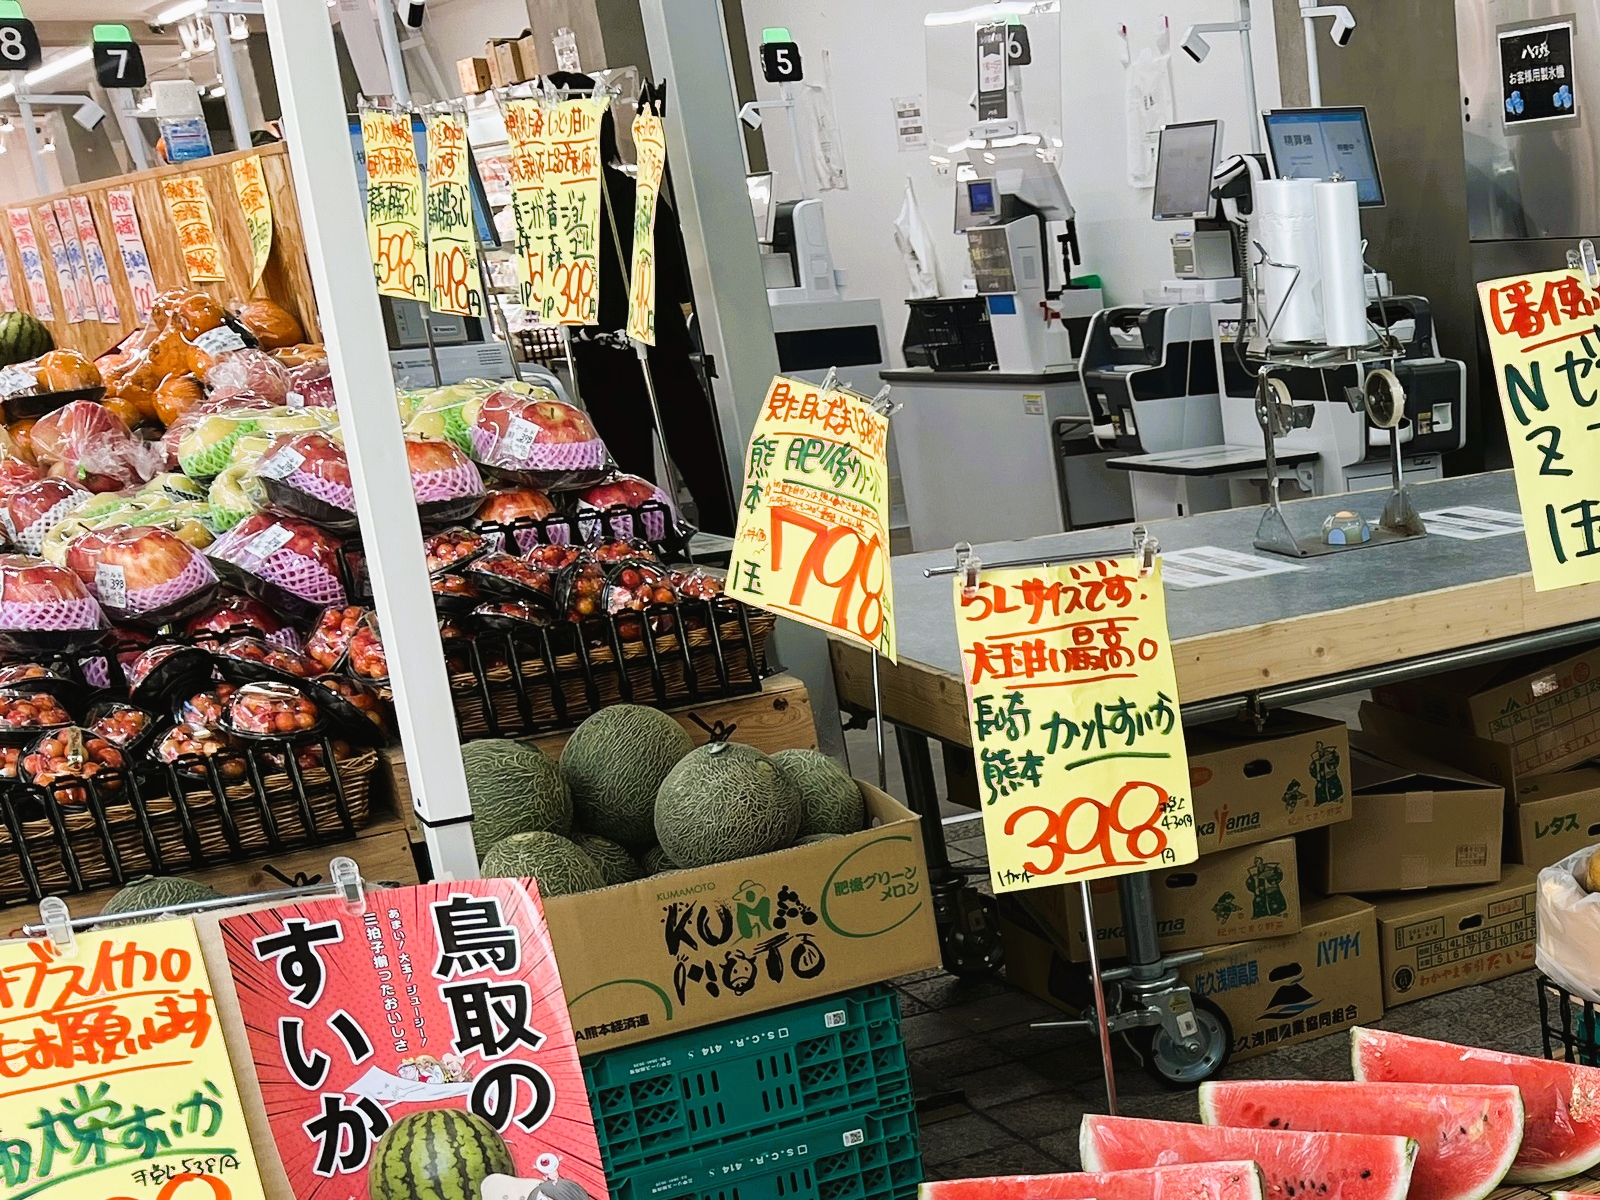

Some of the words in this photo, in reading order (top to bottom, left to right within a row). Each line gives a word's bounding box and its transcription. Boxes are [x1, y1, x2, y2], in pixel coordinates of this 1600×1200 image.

[1, 26, 26, 61] 8
[1008, 33, 1023, 58] 6
[105, 50, 129, 79] 7
[776, 50, 793, 75] 5
[1534, 812, 1581, 840] レタス
[656, 881, 716, 902] KUMAMOTO
[834, 866, 918, 898] 肥後グリーン
[879, 881, 921, 901] メロン
[1316, 930, 1362, 968] ハクサイ
[363, 911, 409, 1053] 三拍子揃ったおいしさ
[1195, 960, 1260, 997] 佐久浅間高原
[434, 893, 555, 1132] 鳥取の
[255, 919, 390, 1174] すいか
[701, 1044, 724, 1057] 414
[722, 1161, 743, 1174] 414
